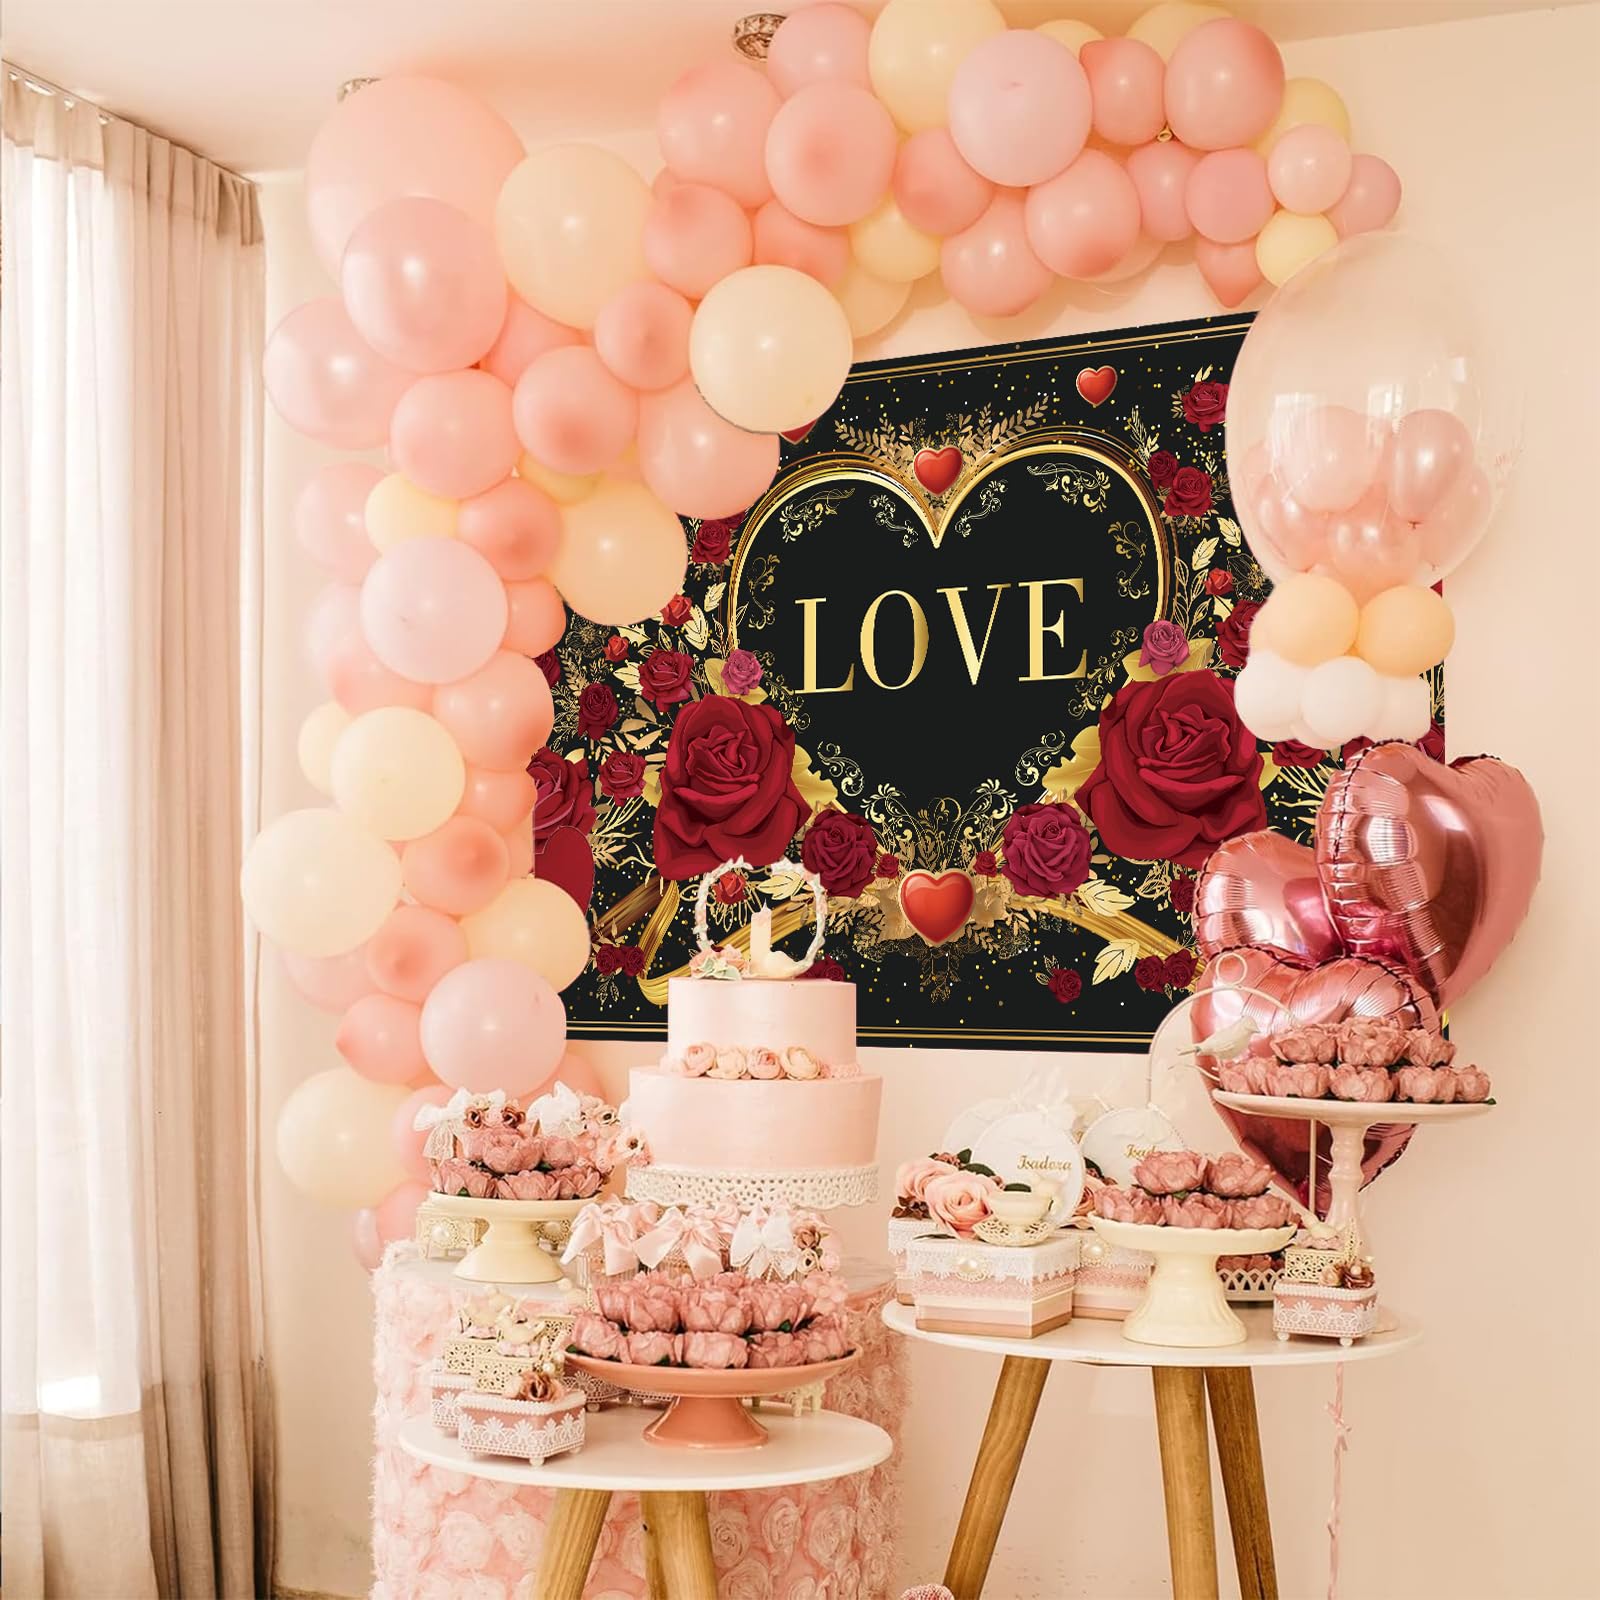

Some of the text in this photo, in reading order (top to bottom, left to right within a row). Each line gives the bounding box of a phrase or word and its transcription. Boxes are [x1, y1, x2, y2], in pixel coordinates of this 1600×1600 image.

[794, 577, 1088, 695] LOVE
[1124, 1143, 1157, 1159] Isad
[1016, 1154, 1072, 1171] Isadora
